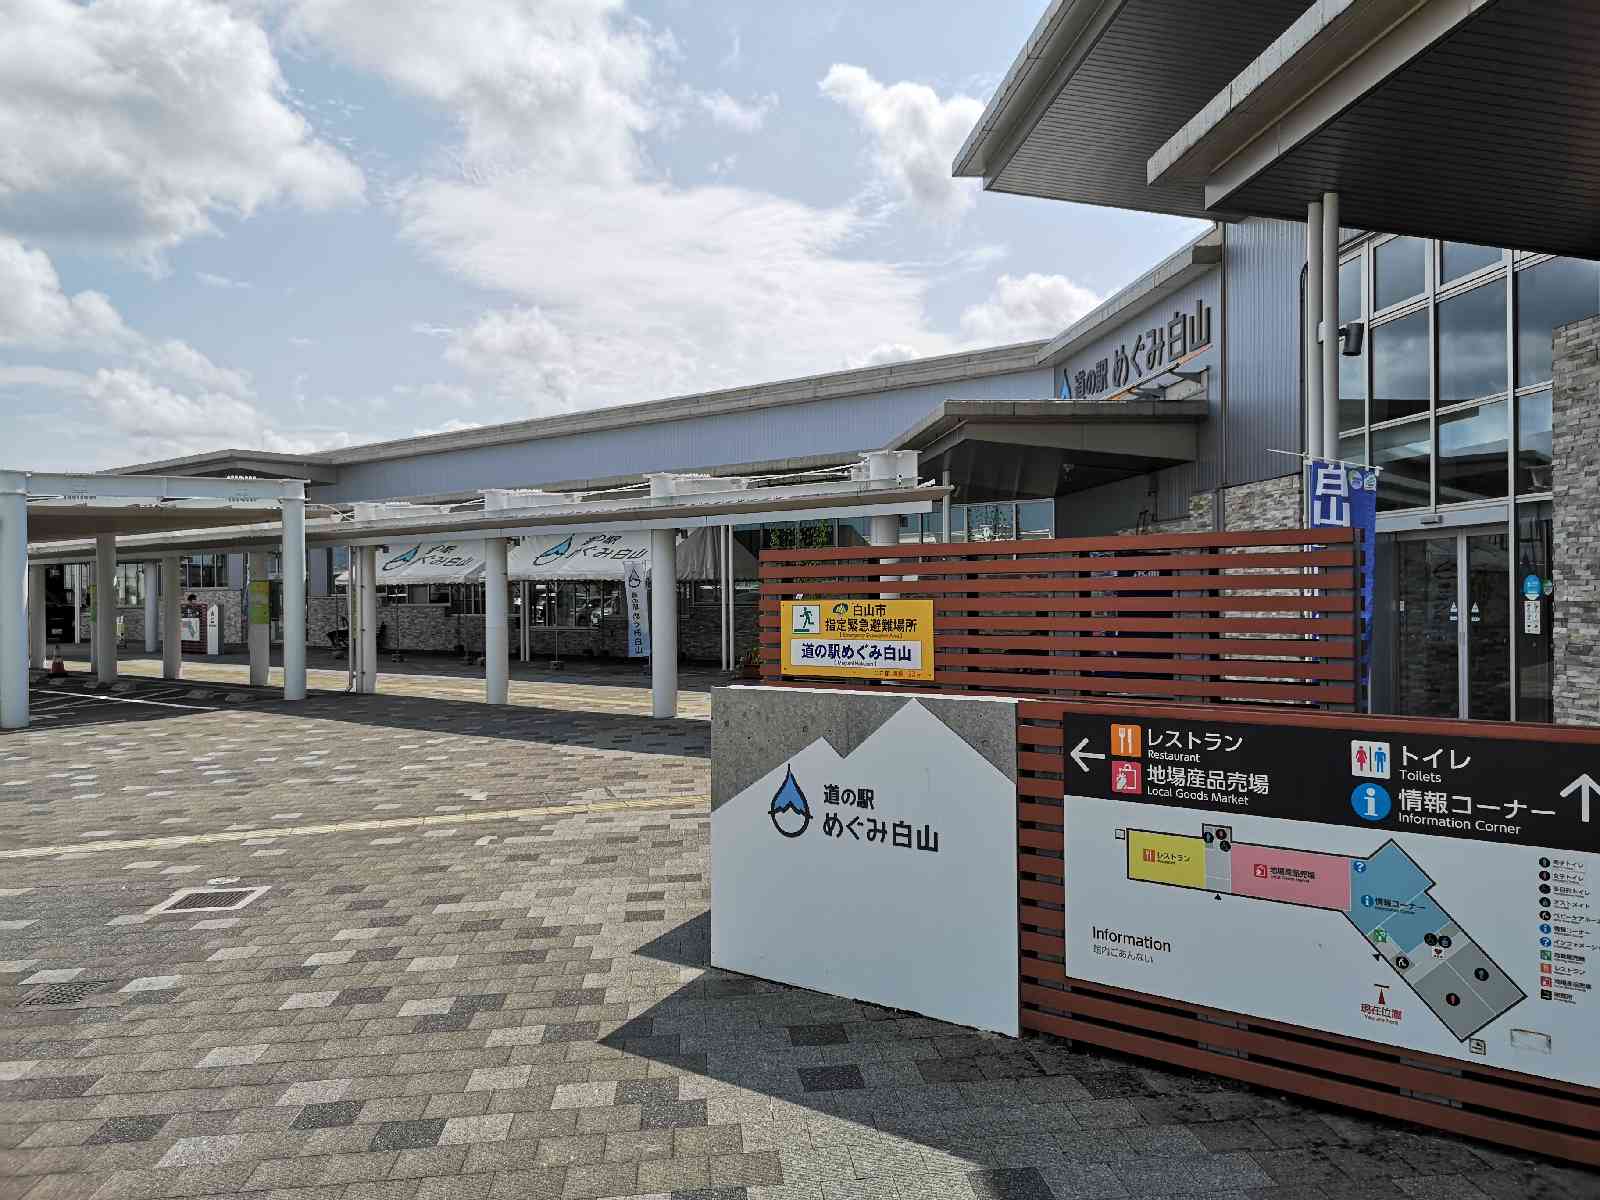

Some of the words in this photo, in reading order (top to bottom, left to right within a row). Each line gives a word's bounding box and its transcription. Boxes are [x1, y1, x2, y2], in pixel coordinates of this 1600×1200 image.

[1074, 357, 1109, 399] 道の駅
[1113, 300, 1211, 387] めぐみ白山
[1313, 463, 1351, 526] 白山
[852, 603, 887, 617] 白山市
[825, 618, 918, 633] 指定緊急避難場所
[801, 642, 912, 662] 道の駅めぐみ白山
[1147, 728, 1243, 752] レストラン
[1148, 750, 1201, 763] Restaurant
[1401, 745, 1472, 770] トイレ
[1146, 764, 1270, 795] 地場産品売場
[1400, 769, 1442, 783] Toilets
[823, 783, 875, 810] 道の駅
[1147, 785, 1173, 798] Local
[1175, 788, 1209, 801] Goods
[1210, 792, 1249, 806] Market
[1398, 788, 1557, 819] 情報コーナー
[822, 812, 940, 853] めぐみ白山
[1398, 813, 1472, 830] Information
[1475, 820, 1521, 835] Corner
[1092, 925, 1171, 953] Information
